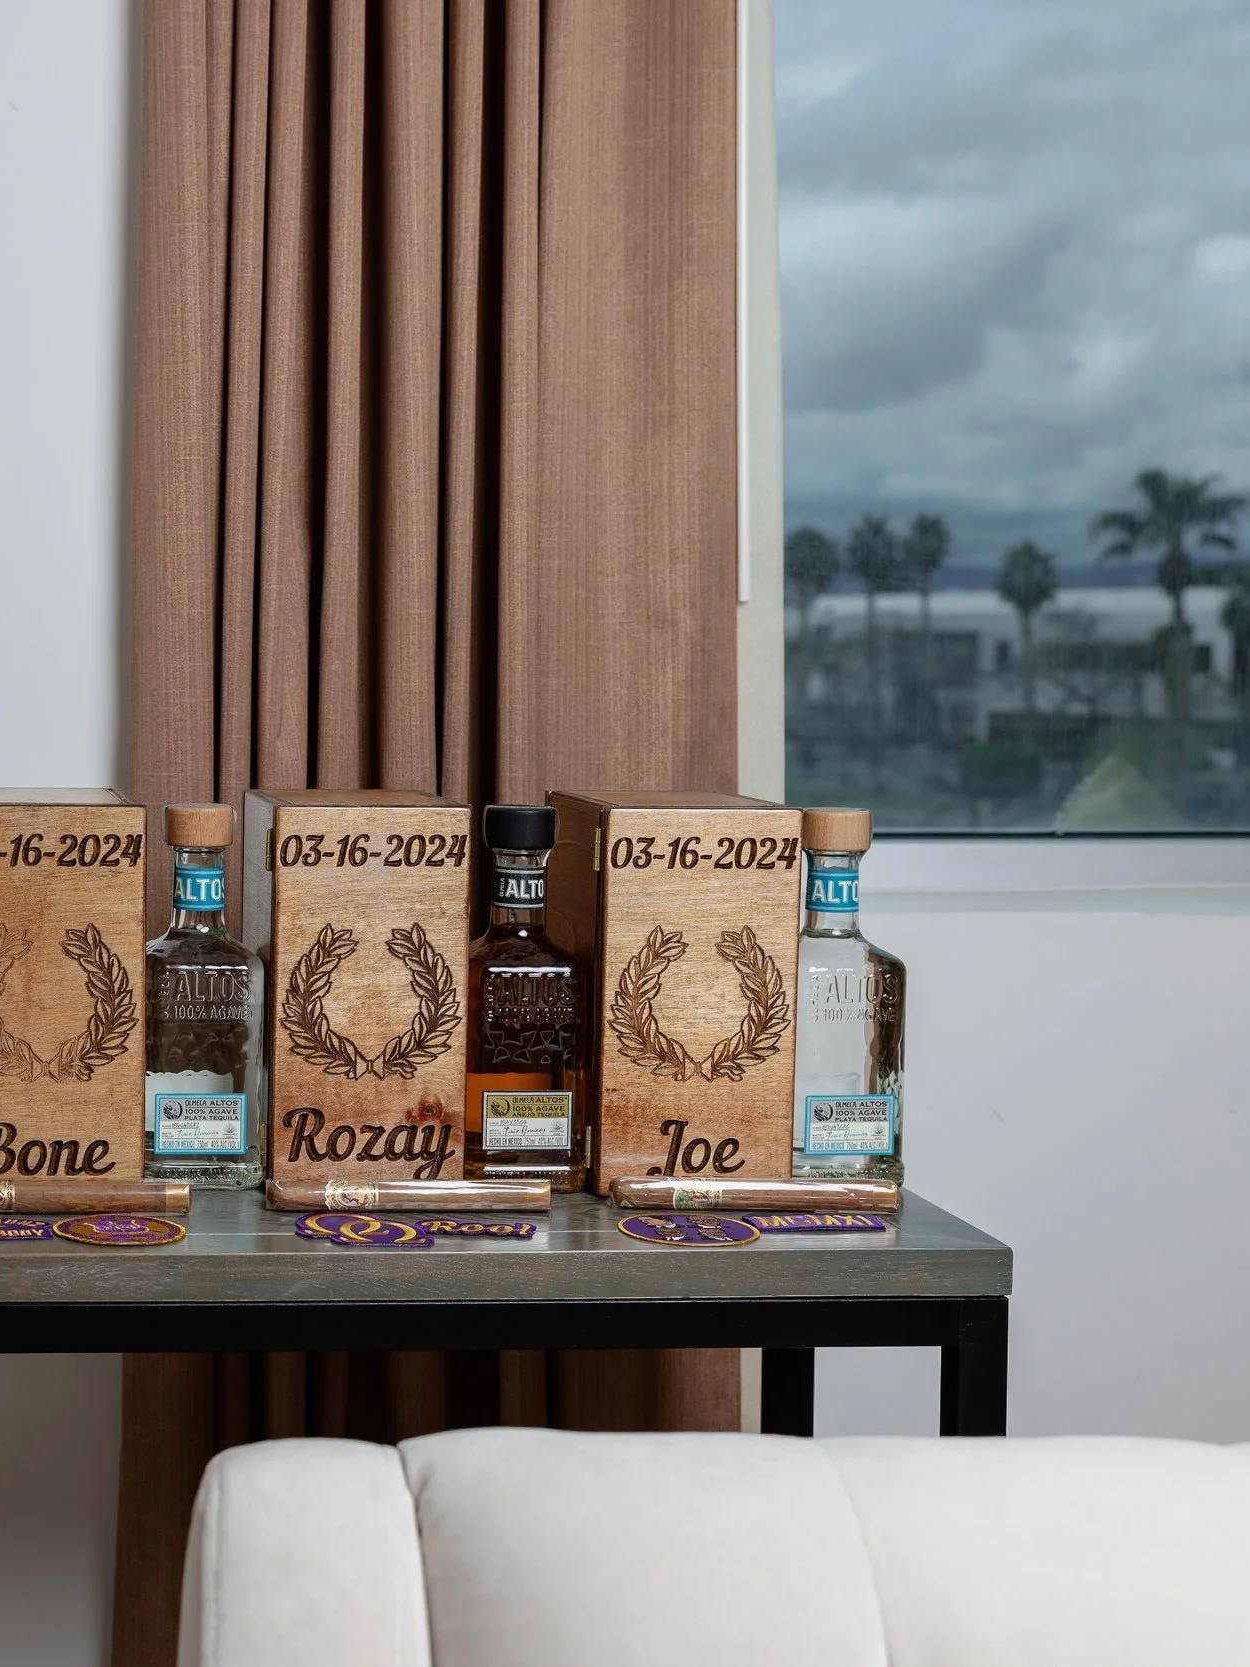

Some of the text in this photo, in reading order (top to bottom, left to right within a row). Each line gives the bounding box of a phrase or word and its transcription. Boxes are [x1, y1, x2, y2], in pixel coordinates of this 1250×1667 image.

[279, 833, 466, 868] 03-16-2024
[610, 836, 797, 870] 03-16-2024
[174, 970, 250, 1001] ALTOS
[824, 973, 898, 1004] ALTOS
[174, 1005, 206, 1019] 100%
[282, 1107, 456, 1180] Rozay
[646, 1120, 746, 1176] Joe
[753, 1214, 874, 1227] MCMXI
